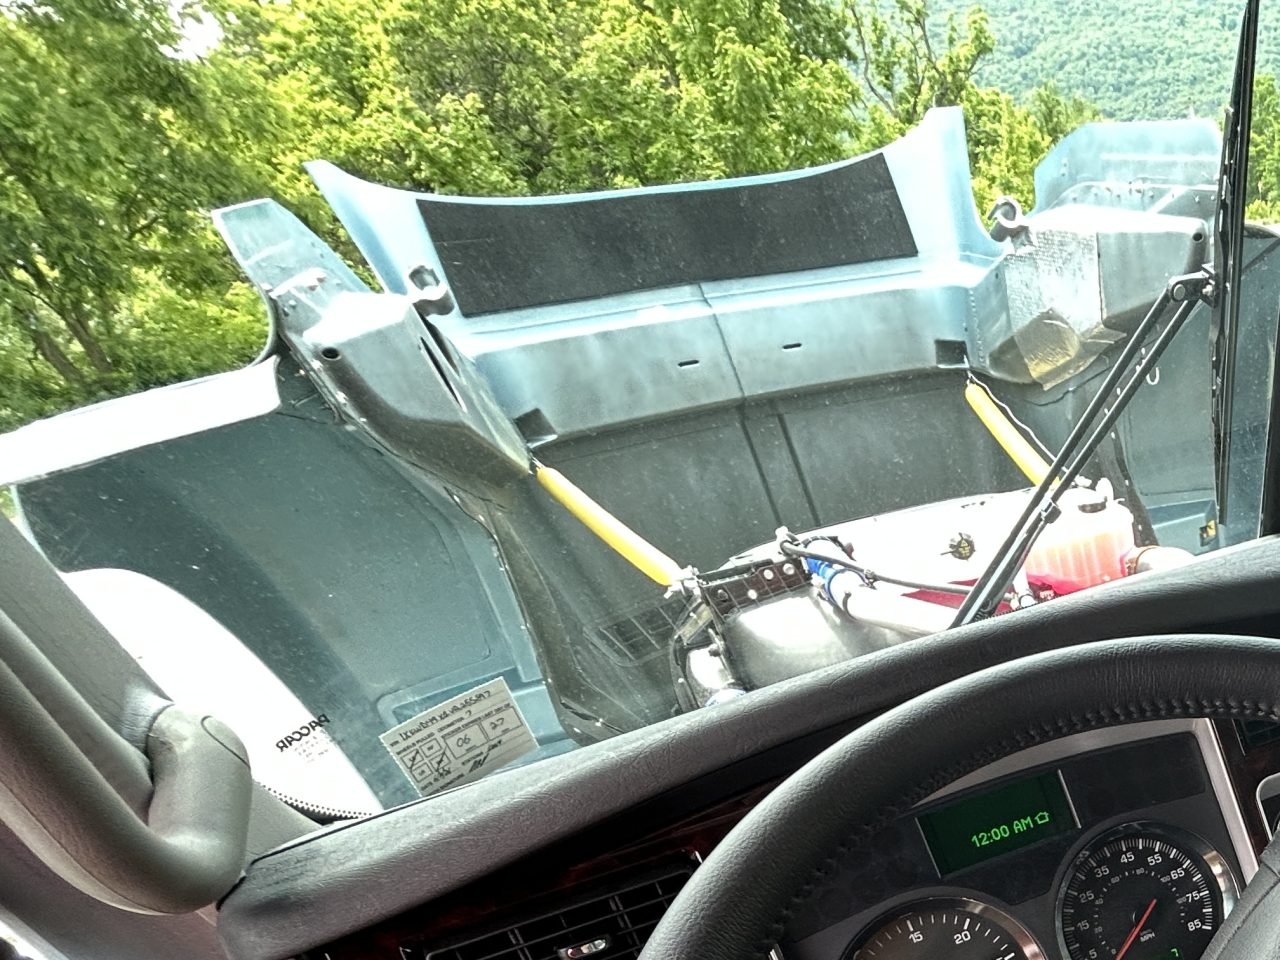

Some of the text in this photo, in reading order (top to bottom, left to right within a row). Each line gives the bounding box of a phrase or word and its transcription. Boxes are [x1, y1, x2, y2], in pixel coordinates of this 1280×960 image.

[971, 817, 1033, 848] 12:00 AM
[1120, 852, 1135, 864] 45
[1147, 853, 1162, 866] 55
[1094, 866, 1109, 878] 35
[1170, 867, 1185, 880] 65
[1079, 890, 1094, 903] 25
[1186, 891, 1201, 903] 75
[1077, 920, 1090, 931] 15
[1187, 919, 1202, 932] 85
[908, 931, 924, 944] 15
[953, 931, 971, 945] 20
[1089, 948, 1097, 959] 5
